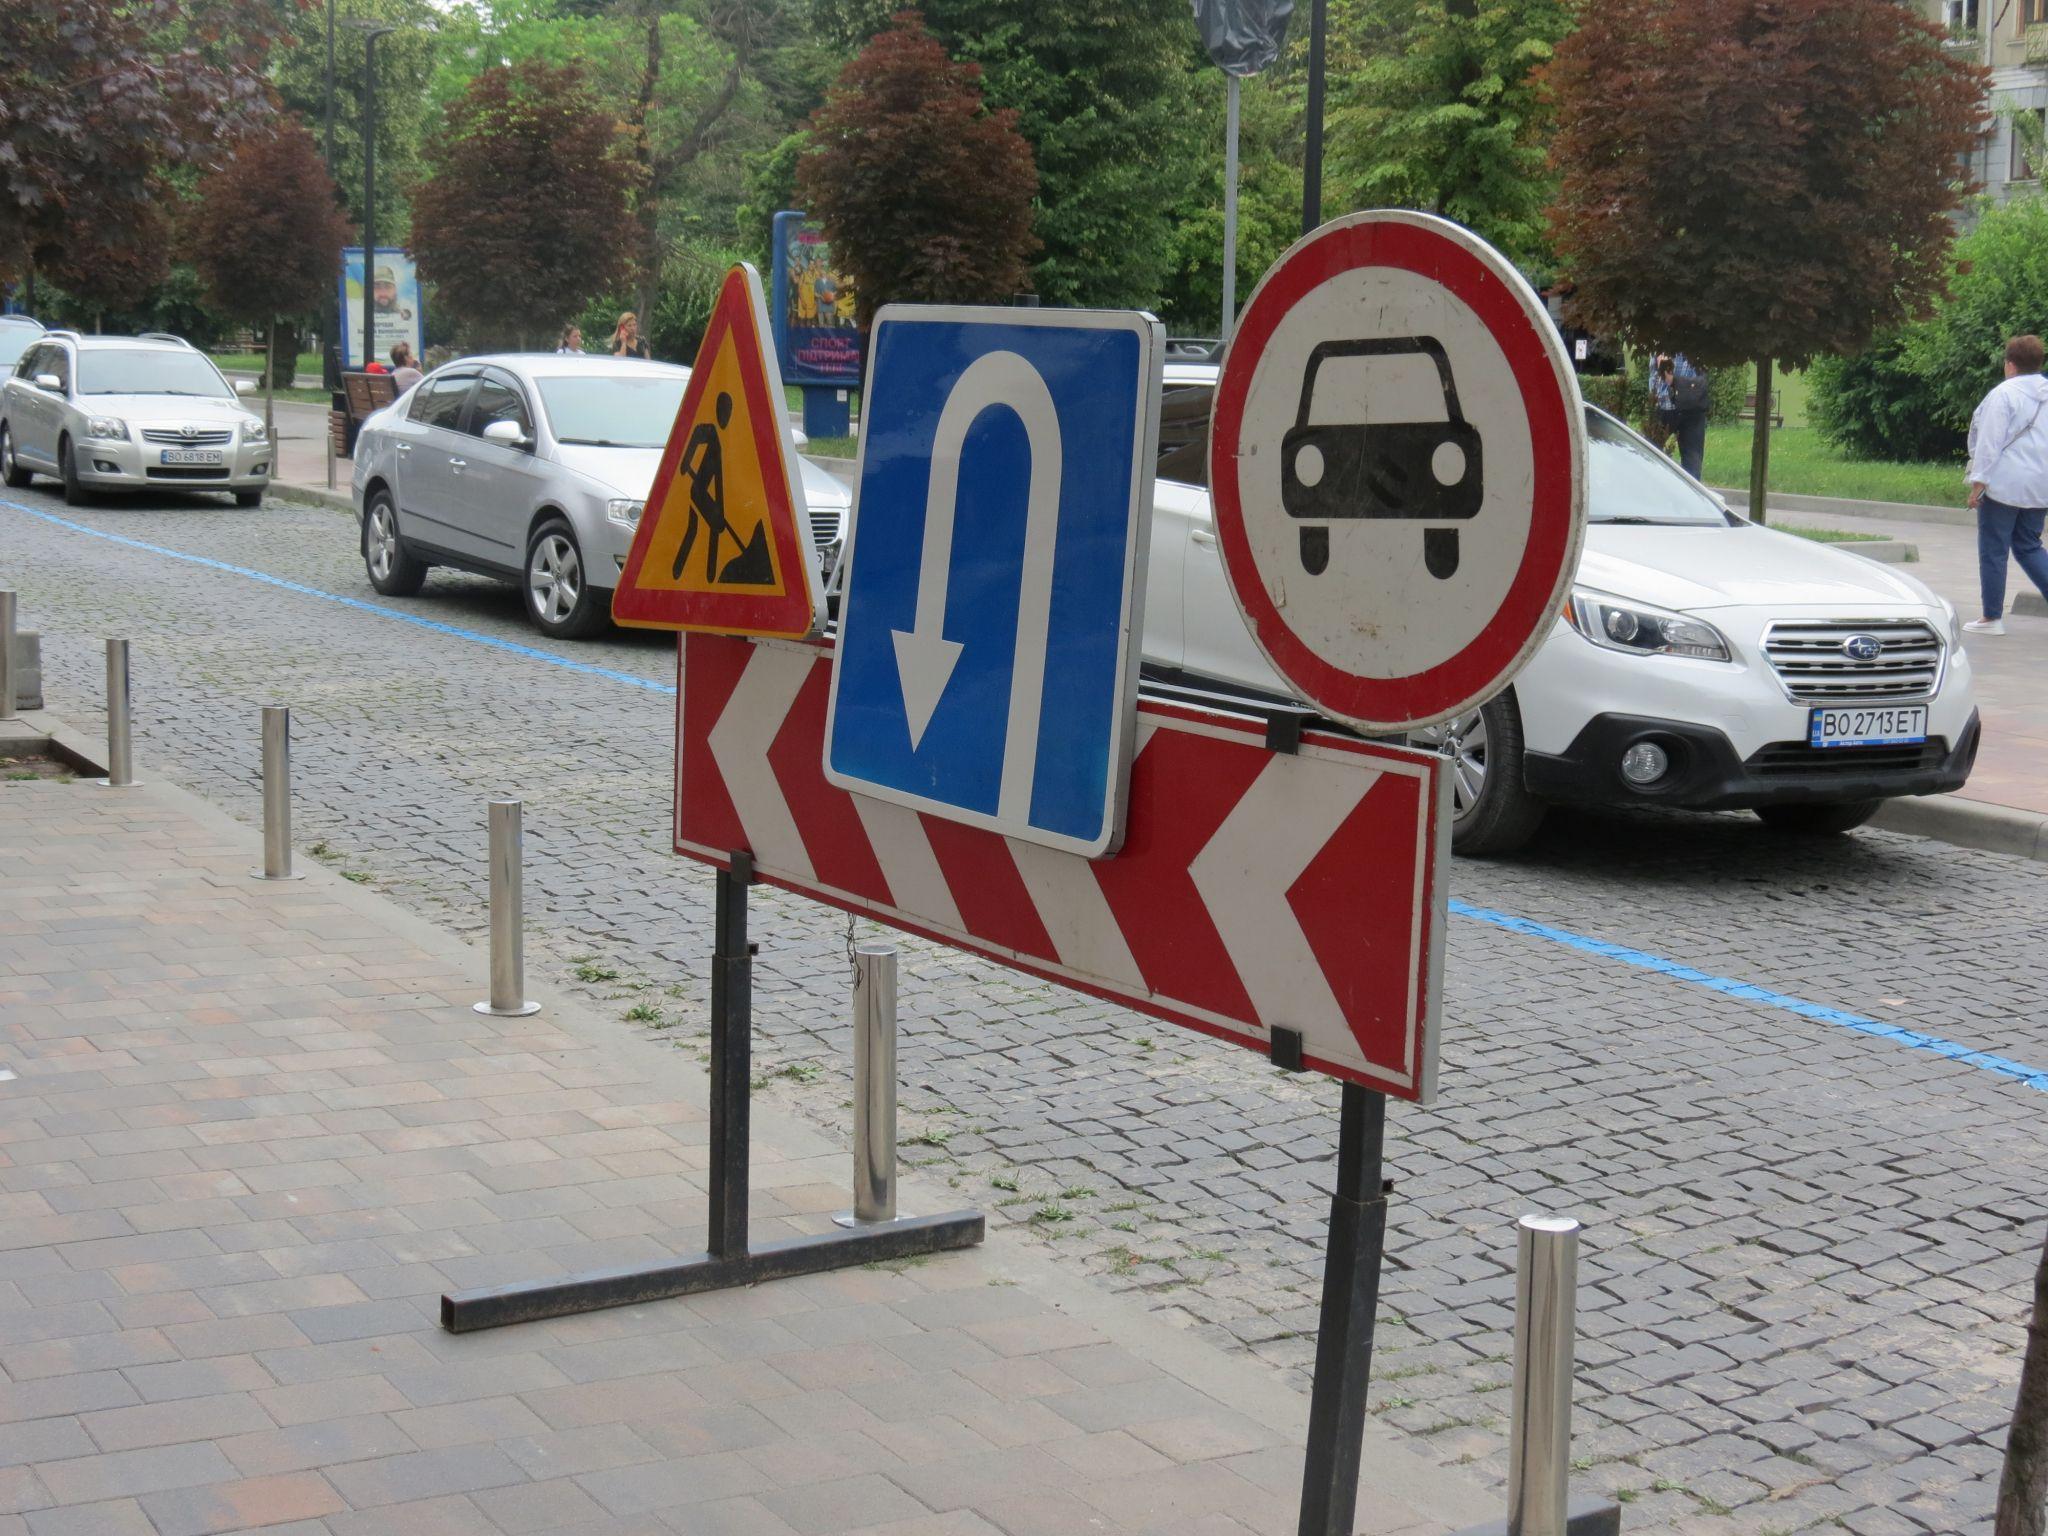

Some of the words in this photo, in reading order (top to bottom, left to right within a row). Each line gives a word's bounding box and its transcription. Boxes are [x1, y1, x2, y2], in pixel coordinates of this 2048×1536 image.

[1823, 713, 1850, 736] BO
[1853, 711, 1893, 735] 2713
[1896, 710, 1922, 733] ET
